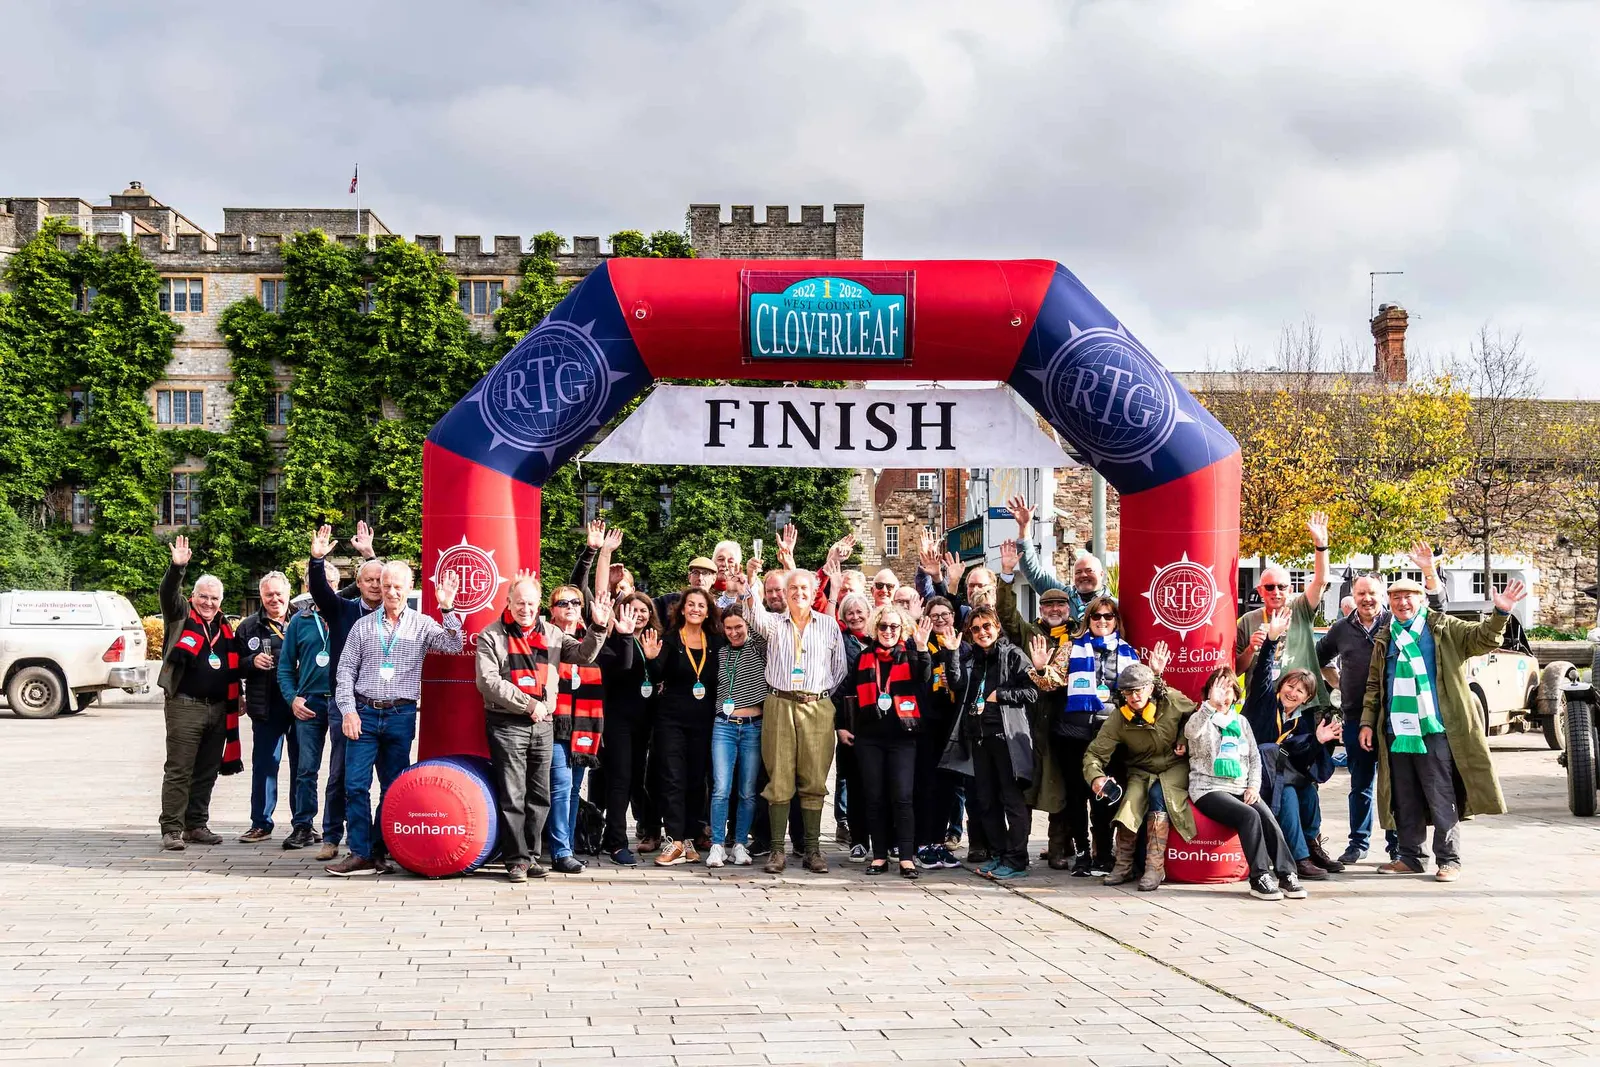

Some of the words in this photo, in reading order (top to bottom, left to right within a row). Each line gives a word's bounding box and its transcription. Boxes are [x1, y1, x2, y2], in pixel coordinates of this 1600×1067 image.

[792, 283, 816, 298] 2022
[822, 280, 832, 298] 1
[839, 282, 863, 298] 2022
[783, 298, 812, 310] WEST
[817, 298, 873, 311] COUNTRY
[755, 302, 901, 356] CLOVERLEAF
[504, 355, 589, 413] RTG
[1065, 364, 1155, 427] RTG
[703, 399, 957, 452] FINISH
[1162, 581, 1208, 611] RTG
[1177, 646, 1188, 663] the
[1189, 647, 1226, 663] Globe
[393, 822, 467, 835] Bonhams
[1168, 848, 1242, 862] Bonhams
